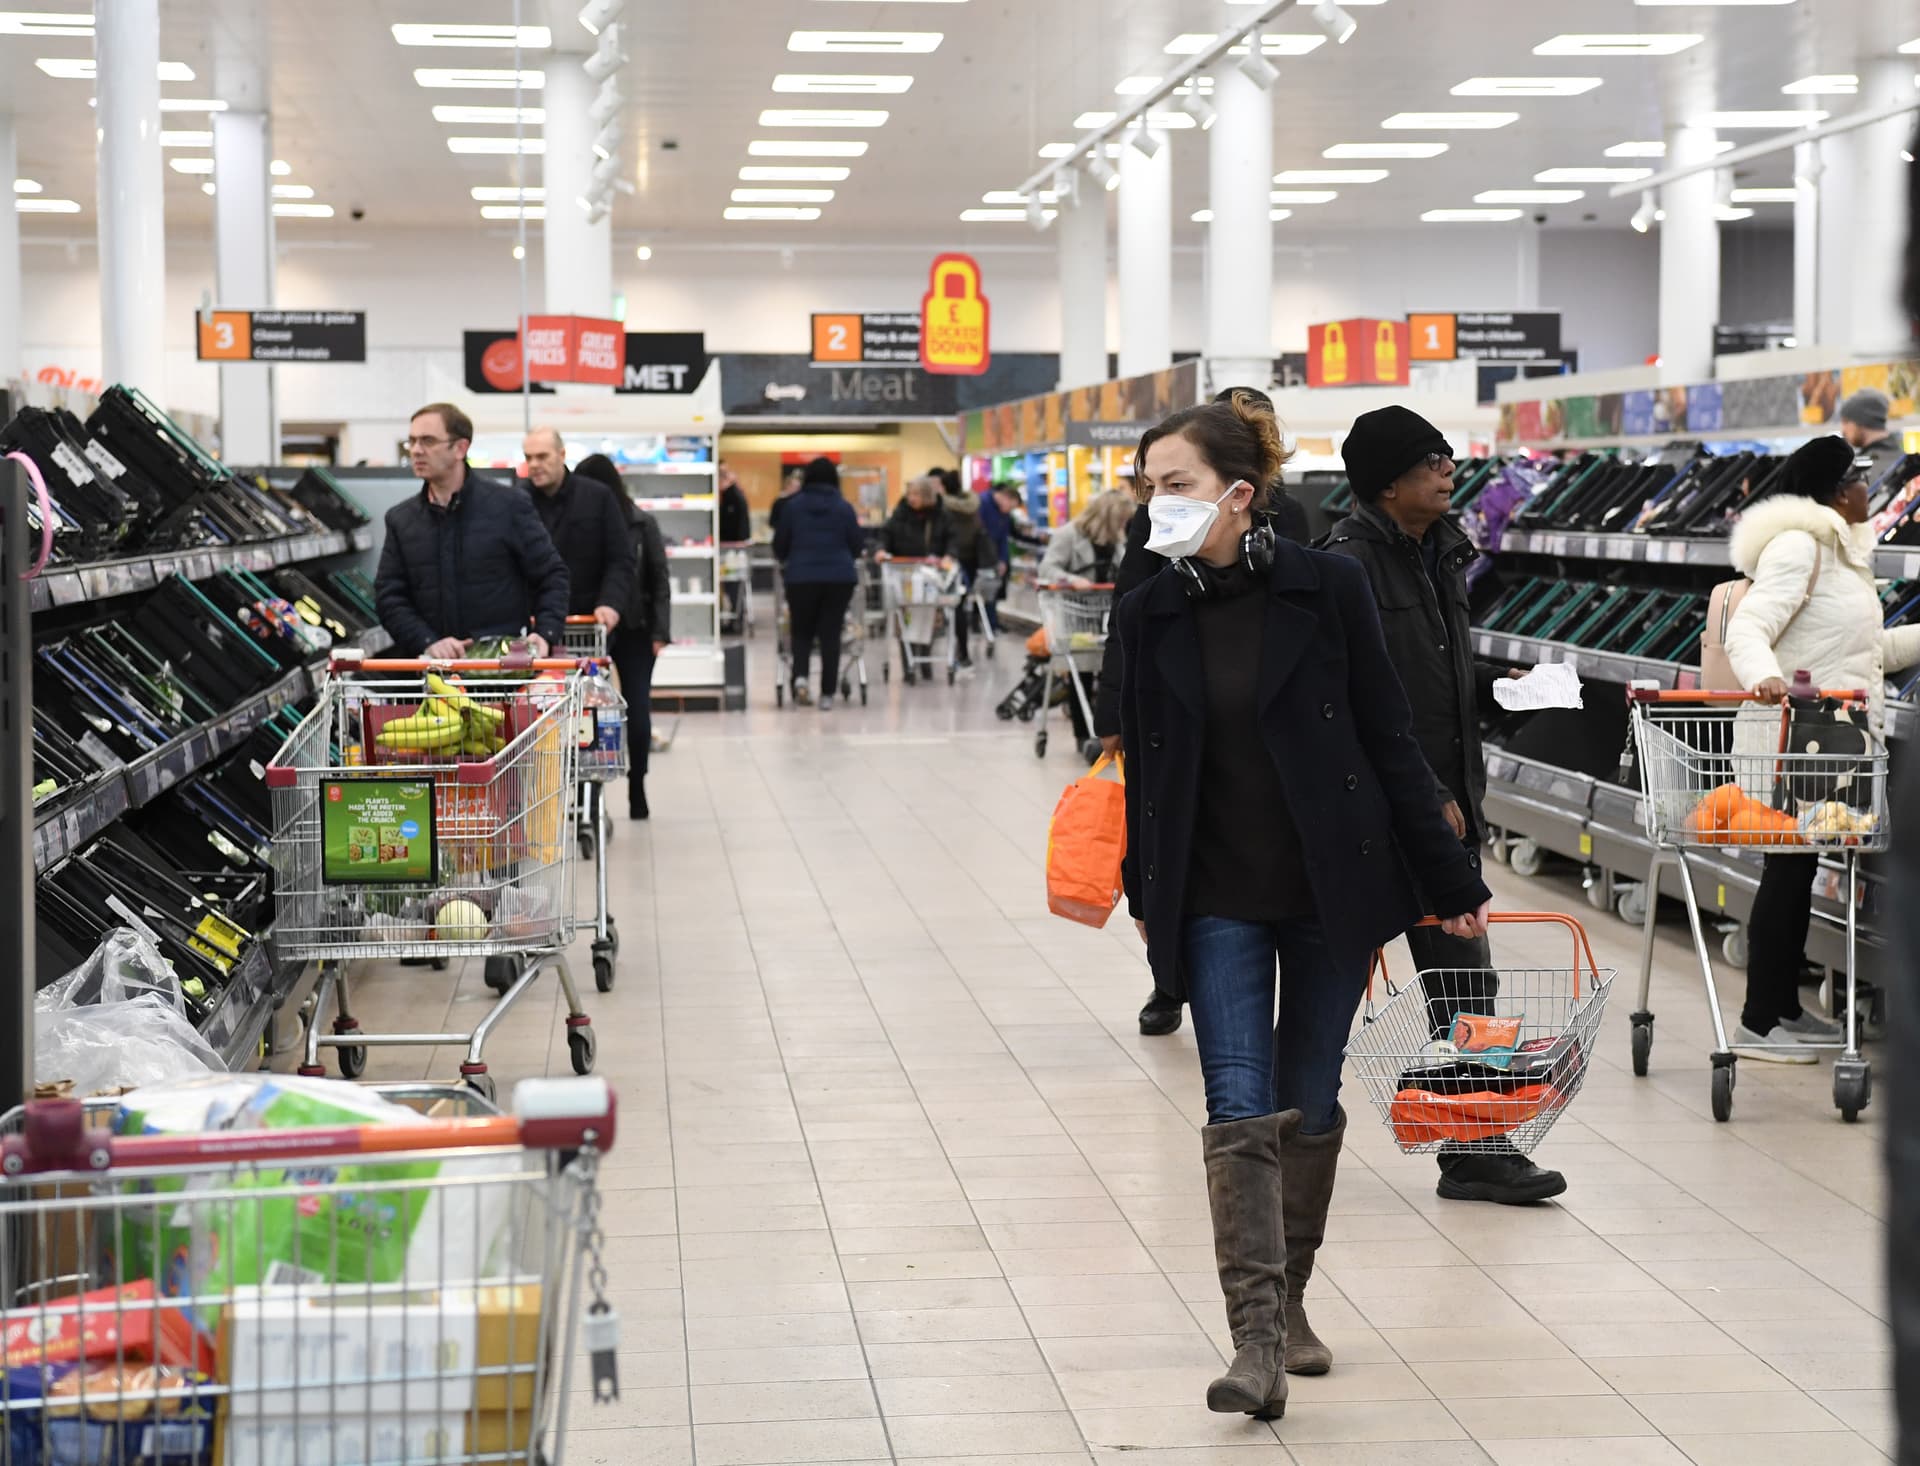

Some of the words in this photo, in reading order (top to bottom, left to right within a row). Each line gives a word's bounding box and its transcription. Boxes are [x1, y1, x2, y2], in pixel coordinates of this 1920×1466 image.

[215, 322, 234, 349] 3
[253, 329, 292, 342] Cheese
[528, 329, 566, 346] GREAT
[580, 331, 616, 348] GREAT
[828, 325, 847, 350] 2
[1424, 325, 1441, 350] 1
[527, 347, 567, 366] PRICES
[930, 340, 979, 354] DOWN
[578, 350, 617, 369] PRICES
[831, 369, 918, 401] Meat
